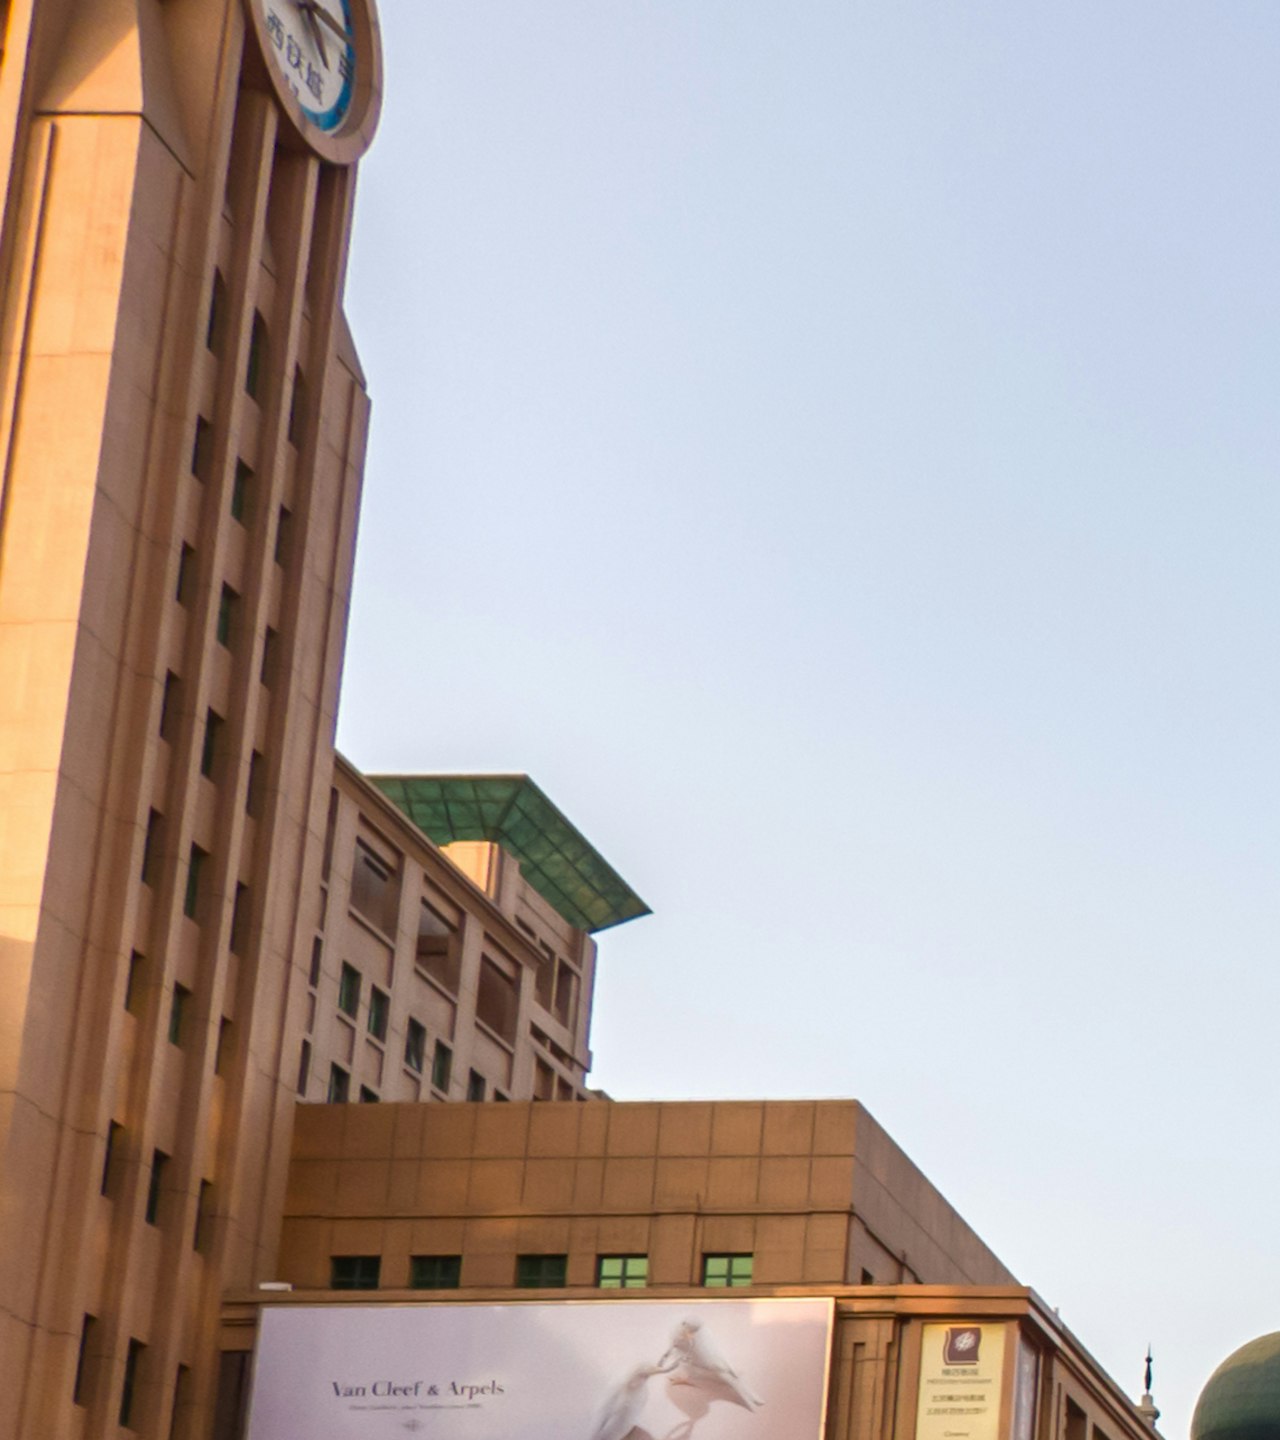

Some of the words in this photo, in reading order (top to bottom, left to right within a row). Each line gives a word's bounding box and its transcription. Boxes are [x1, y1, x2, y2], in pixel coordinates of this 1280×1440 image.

[333, 1381, 366, 1397] Van
[372, 1380, 423, 1397] Cleef
[427, 1384, 439, 1396] &
[450, 1380, 504, 1399] Arpels
